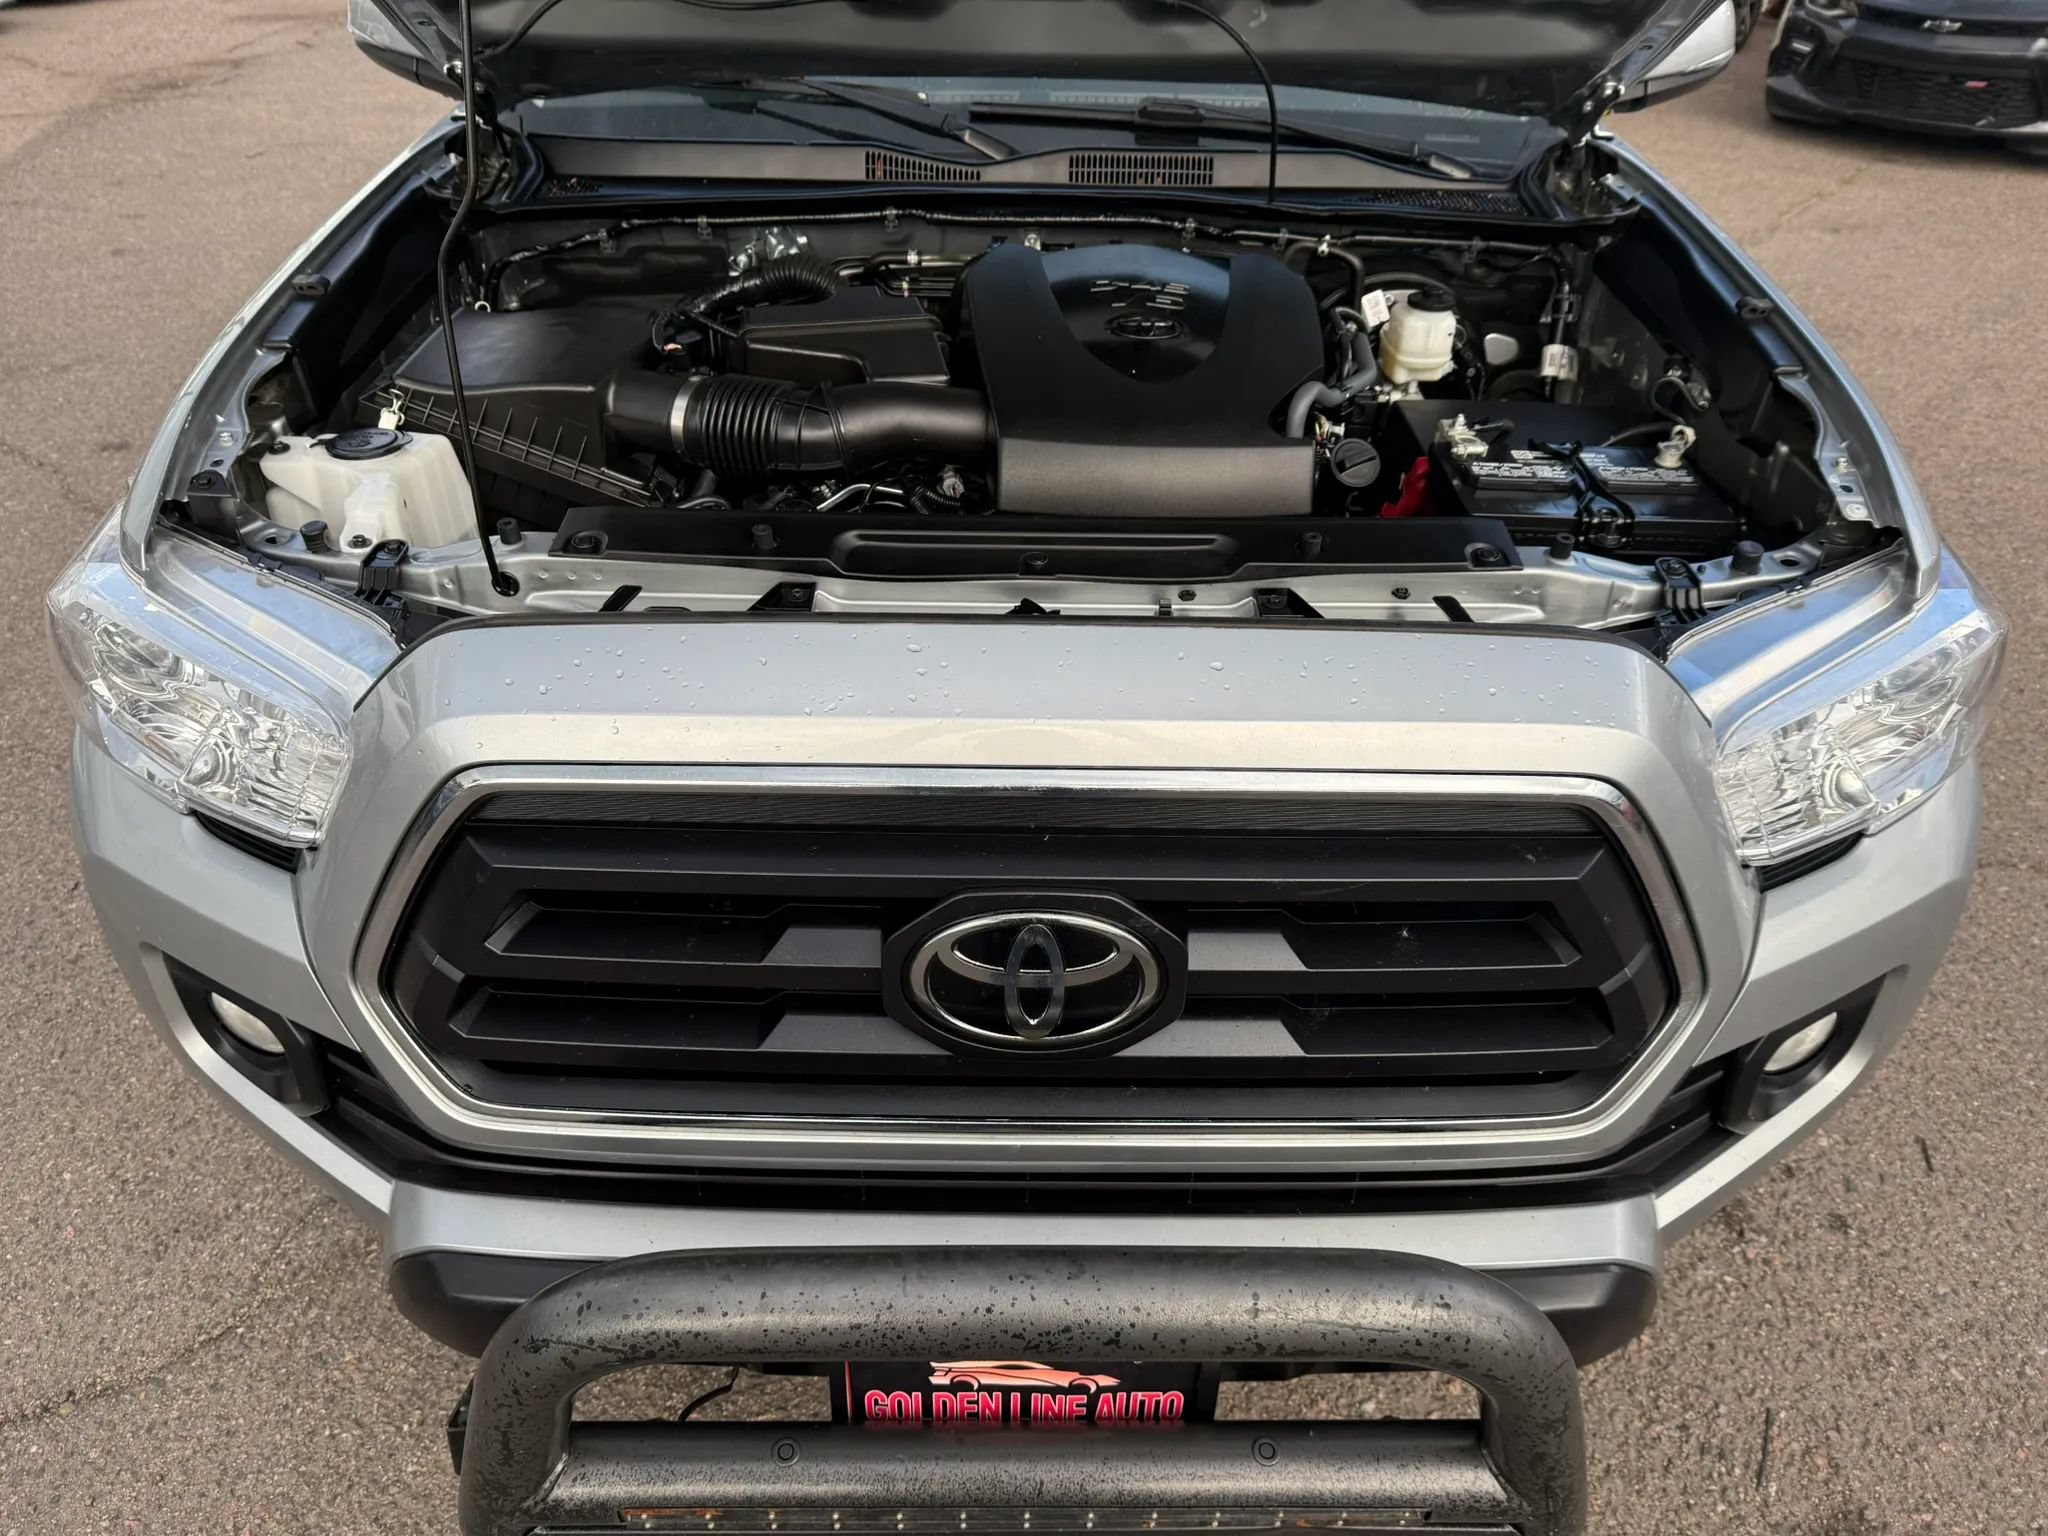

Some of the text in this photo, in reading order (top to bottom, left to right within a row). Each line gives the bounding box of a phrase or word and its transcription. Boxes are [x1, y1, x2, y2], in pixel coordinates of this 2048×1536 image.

[864, 1389, 1185, 1422] GOLDEN LINE AUTO
